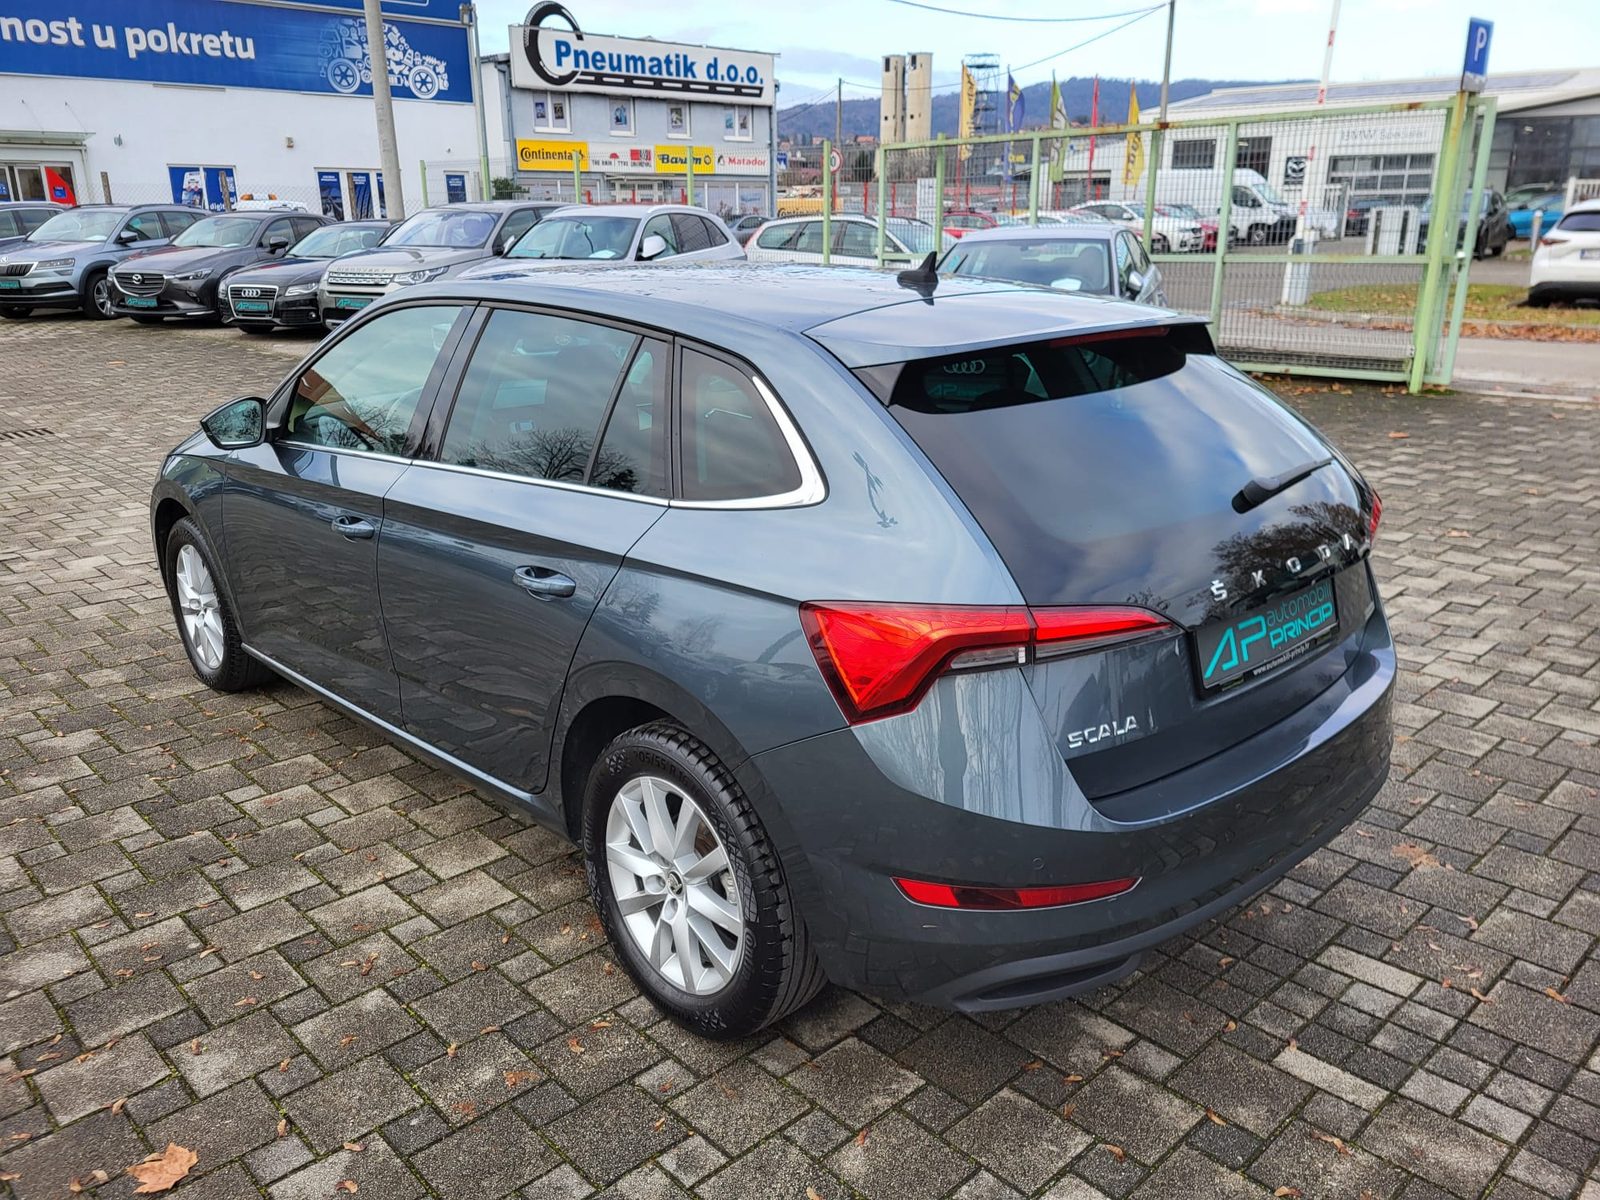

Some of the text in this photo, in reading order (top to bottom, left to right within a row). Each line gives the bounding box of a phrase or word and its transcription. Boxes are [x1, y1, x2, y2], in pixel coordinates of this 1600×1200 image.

[0, 16, 256, 59] nost u pokretu
[1474, 26, 1488, 62] P
[554, 39, 764, 85] Pneumatik d.o.o.
[520, 147, 577, 162] Continenta
[728, 156, 766, 166] Matador
[1267, 581, 1333, 627] automobili
[1203, 614, 1267, 680] AP
[1269, 602, 1333, 650] PRINCIP
[1067, 715, 1138, 749] SCALA
